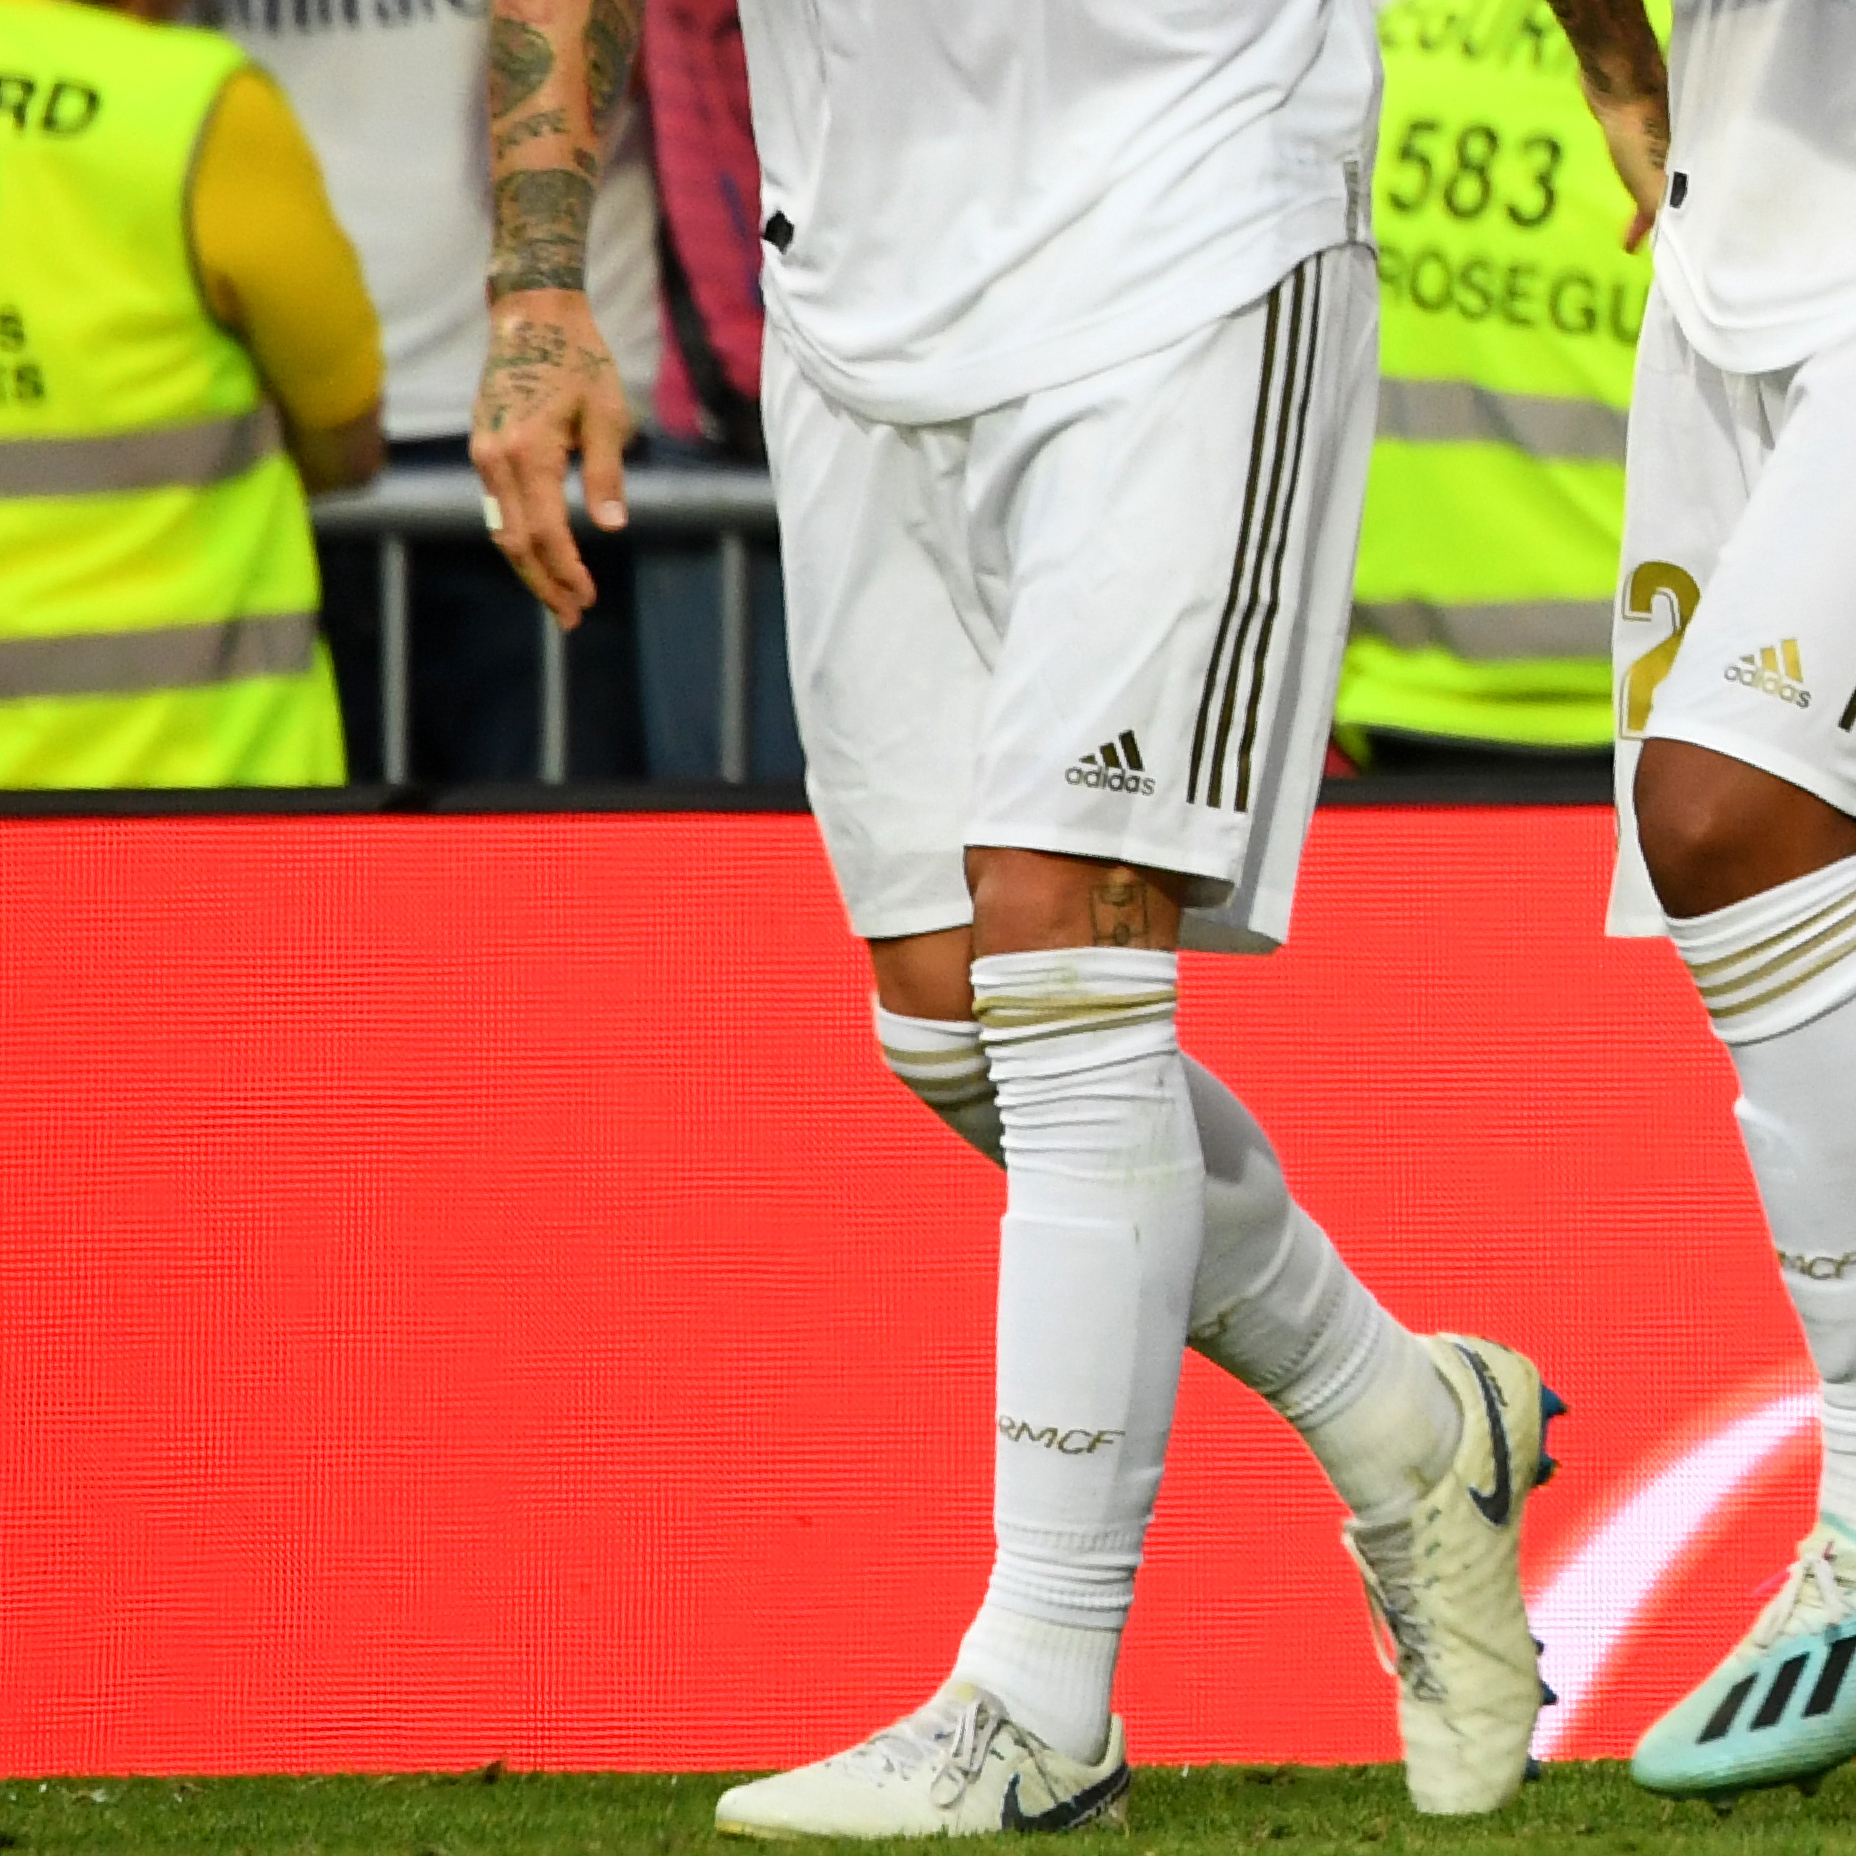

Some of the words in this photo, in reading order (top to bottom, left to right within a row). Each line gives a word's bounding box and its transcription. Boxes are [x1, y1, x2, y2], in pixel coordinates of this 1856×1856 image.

[1388, 118, 1562, 228] 583
[1724, 665, 1812, 709] adidas
[1065, 763, 1156, 797] adidas
[998, 1414, 1126, 1455] RMCF
